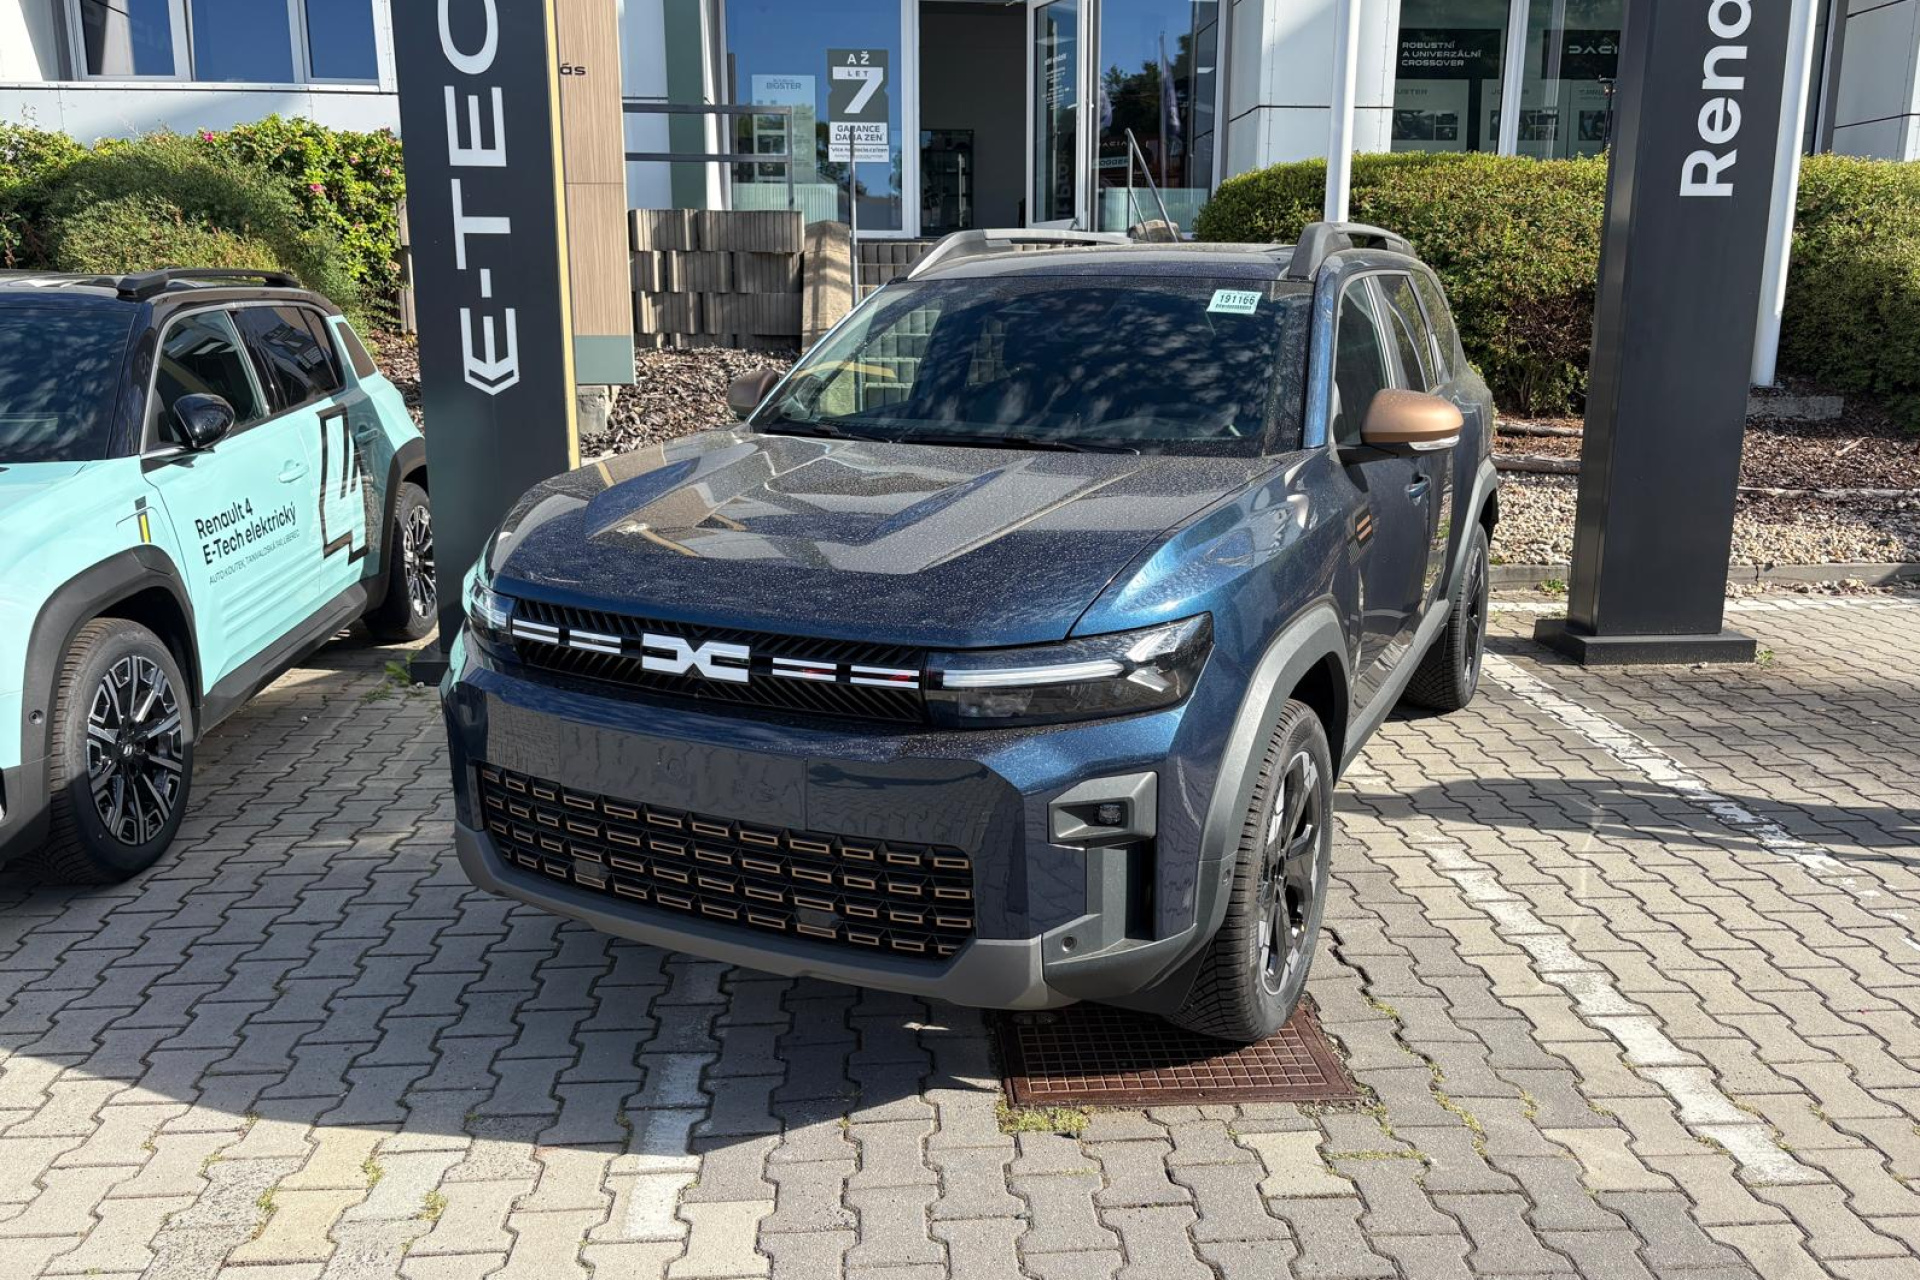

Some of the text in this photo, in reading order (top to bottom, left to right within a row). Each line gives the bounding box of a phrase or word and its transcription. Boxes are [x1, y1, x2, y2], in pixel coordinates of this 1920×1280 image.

[1401, 41, 1455, 49] ROBUSTNÍ
[847, 51, 870, 65] AŽ
[1412, 49, 1482, 58] UNIVERZÁLNÍ
[1401, 59, 1465, 67] CROSSOVER
[832, 66, 884, 113] 7
[1680, 0, 1751, 196] Rena
[1220, 294, 1256, 305] 191166
[194, 497, 253, 539] Renault 4
[202, 501, 296, 565] E-Tech elektrický
